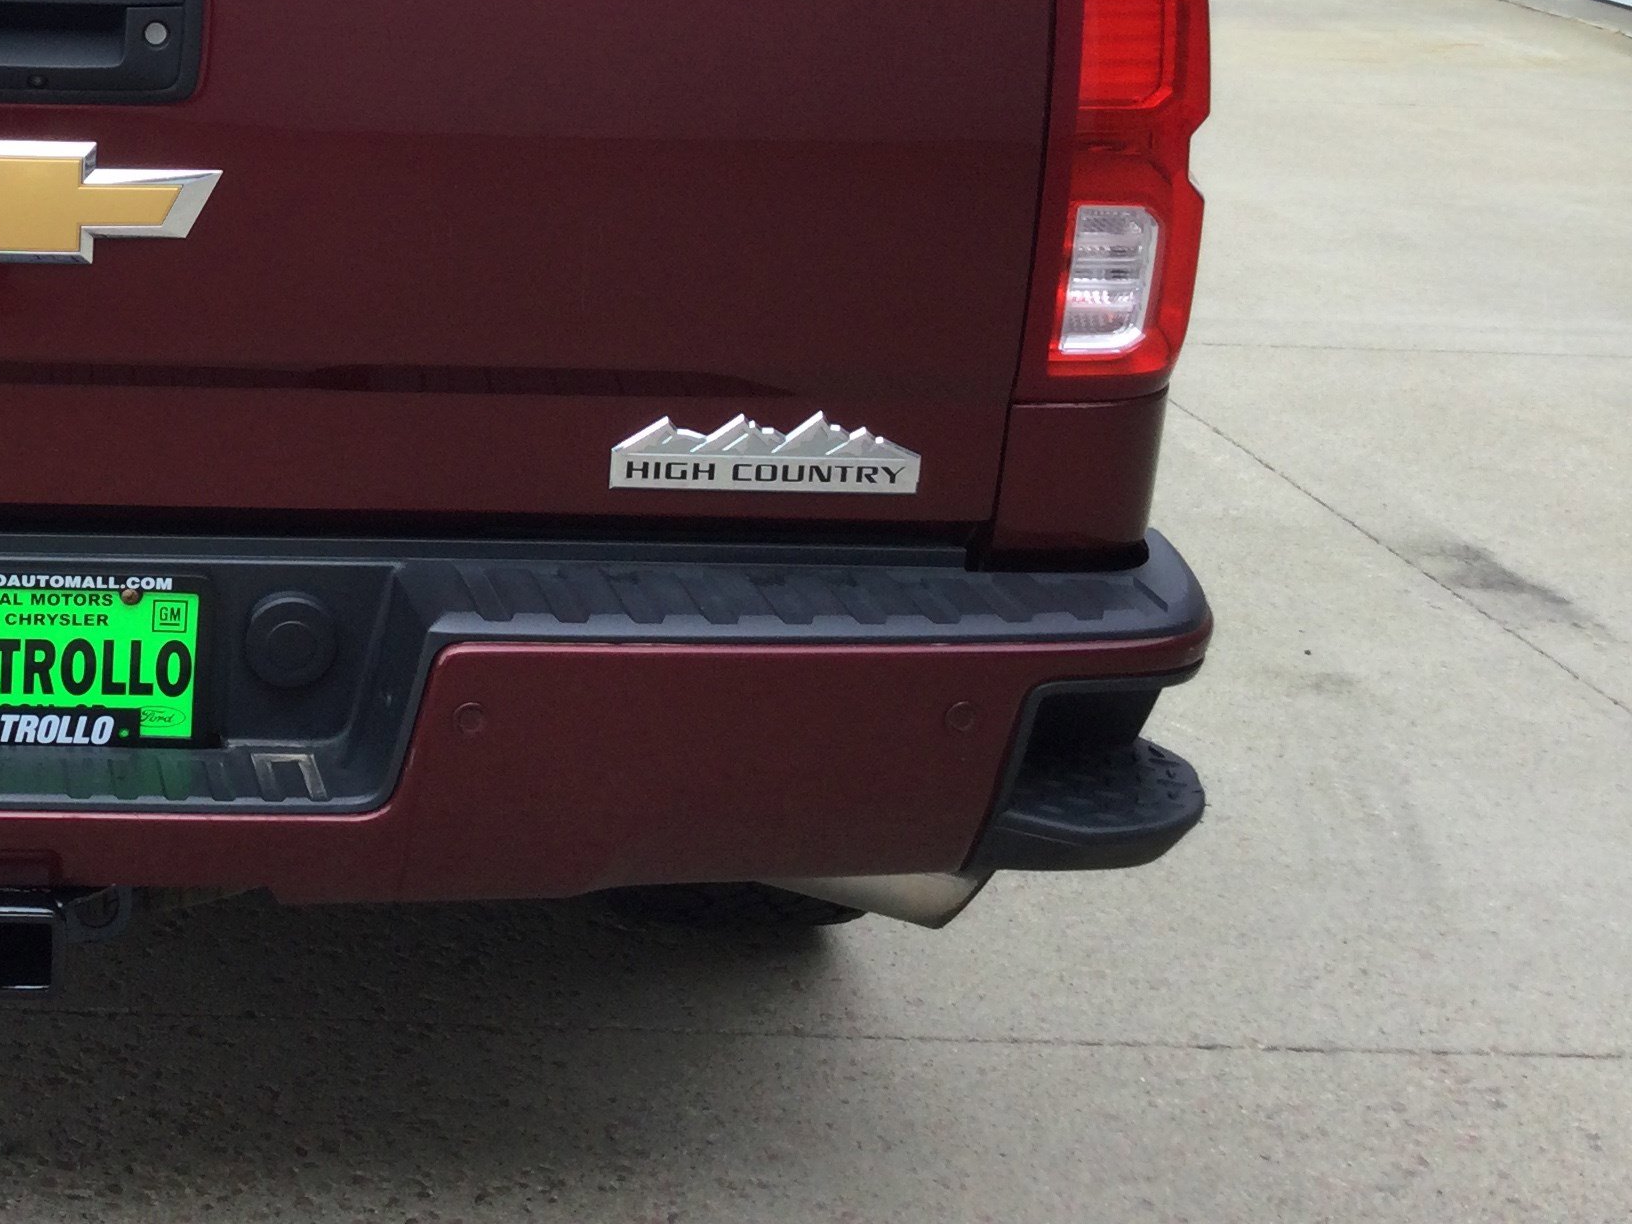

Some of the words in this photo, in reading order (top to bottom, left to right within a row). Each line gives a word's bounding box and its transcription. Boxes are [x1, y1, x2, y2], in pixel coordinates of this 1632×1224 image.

[626, 460, 716, 481] HIGH
[732, 463, 907, 484] COUNTRY
[30, 593, 114, 607] MOTORS
[4, 613, 109, 627] CHRYSLER
[159, 606, 181, 623] GM
[140, 710, 173, 724] Ford
